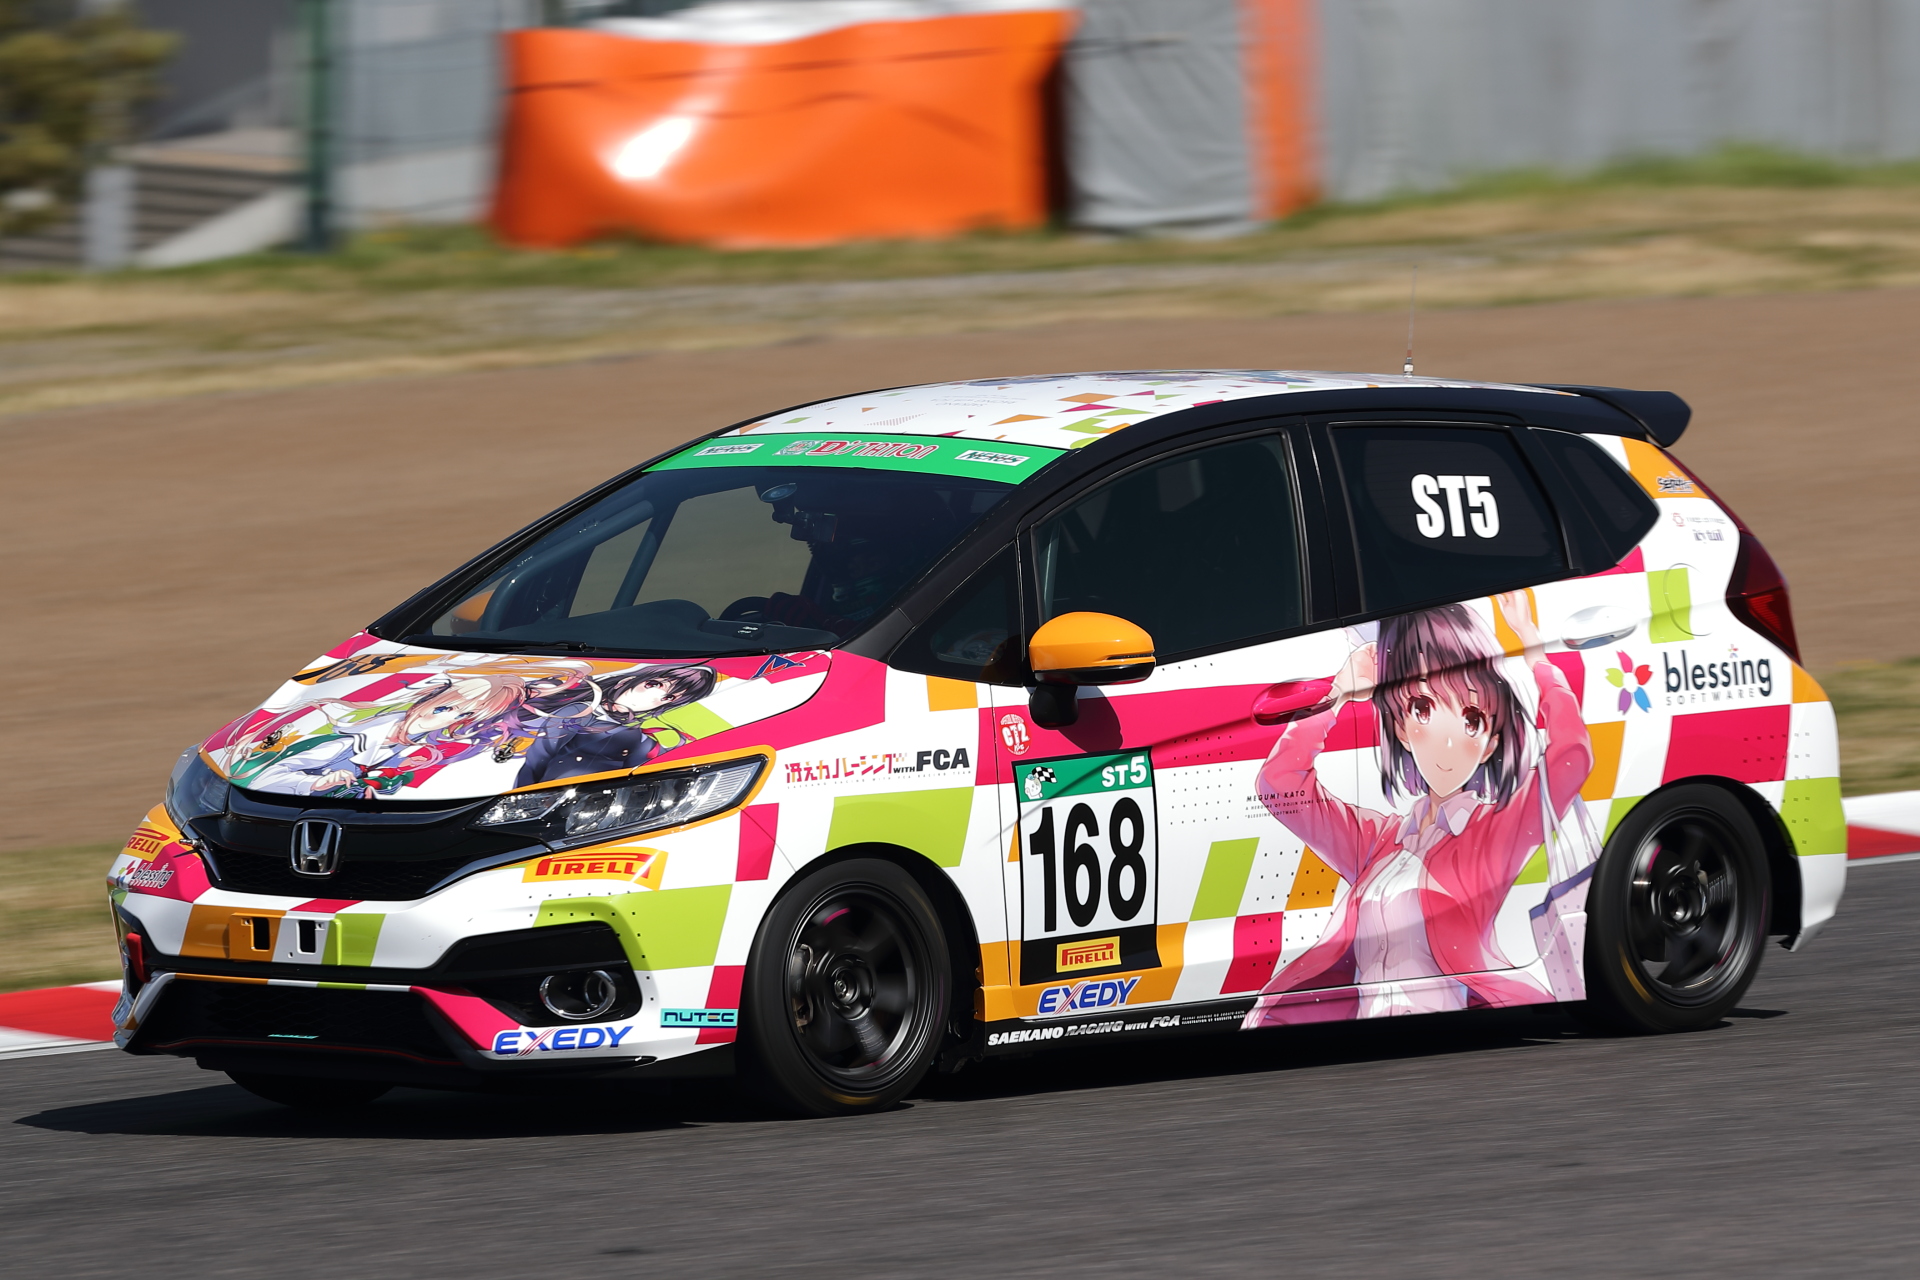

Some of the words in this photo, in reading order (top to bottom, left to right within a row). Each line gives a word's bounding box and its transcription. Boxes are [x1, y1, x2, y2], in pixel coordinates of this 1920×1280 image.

[1411, 473, 1500, 539] ST5
[291, 654, 406, 683] 168
[1663, 649, 1773, 697] blessing
[1666, 687, 1756, 706] SOFTWARE
[893, 766, 916, 774] WITH
[916, 748, 970, 772] FCA
[1101, 755, 1147, 788] ST5
[1246, 793, 1280, 802] MEGUMI
[1284, 790, 1306, 798] KATO
[131, 862, 174, 889] blessing
[535, 852, 655, 879] PIRELLI
[1029, 797, 1147, 933] 168
[1061, 942, 1114, 966] PIRELLI
[1038, 979, 1139, 1015] EXEDY
[664, 1011, 735, 1023] NUTEC
[988, 1027, 1064, 1046] SAEKANO
[1064, 1021, 1124, 1037] RACING
[1125, 1022, 1148, 1031] WITH
[1149, 1015, 1180, 1029] FCA
[494, 1026, 633, 1056] EXEDY
